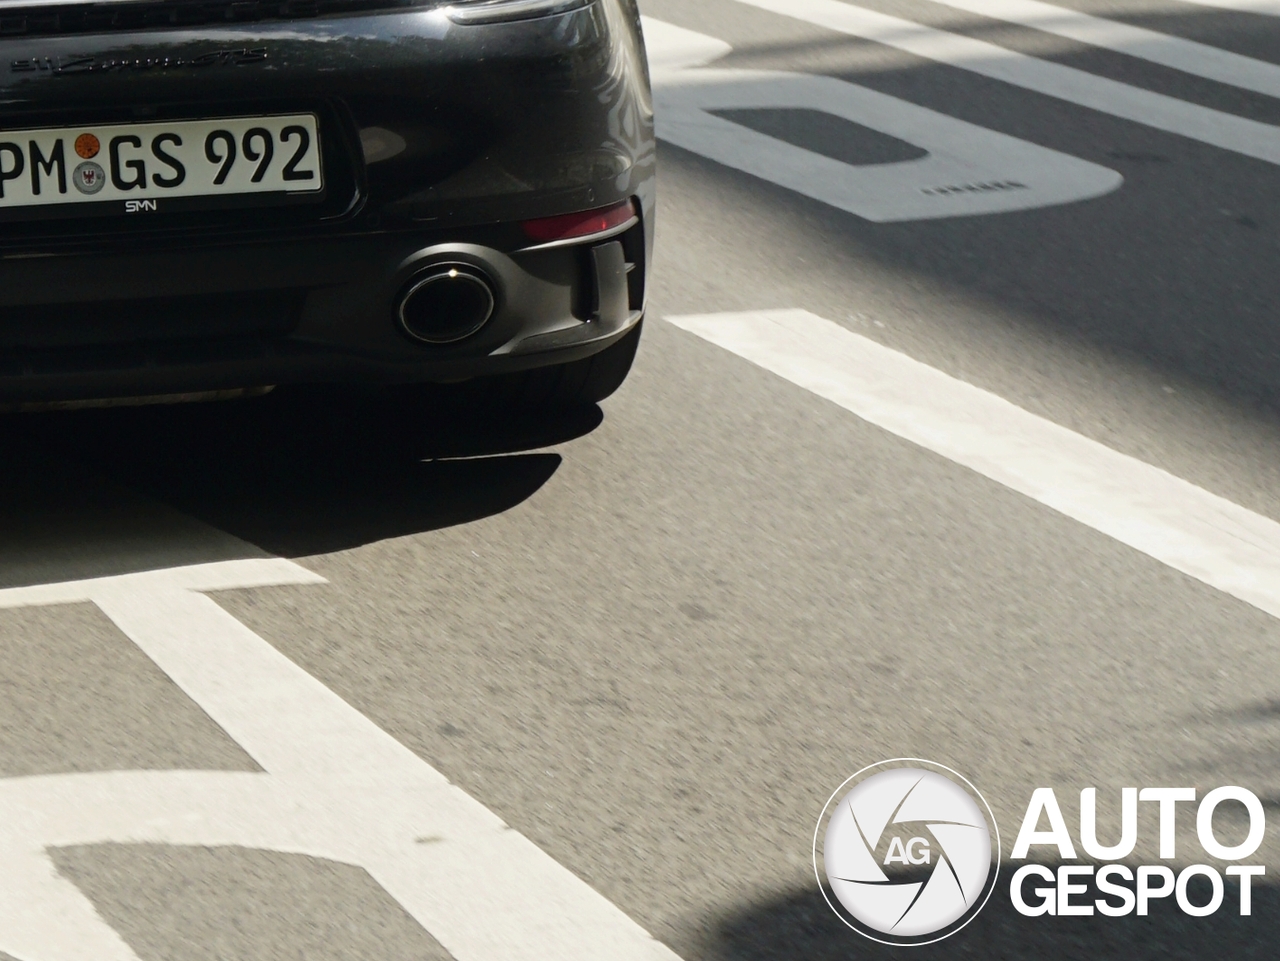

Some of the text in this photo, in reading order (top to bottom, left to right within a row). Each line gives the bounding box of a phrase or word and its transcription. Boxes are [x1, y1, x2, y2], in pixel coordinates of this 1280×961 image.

[108, 132, 187, 191] GS
[204, 124, 315, 186] 992
[125, 199, 158, 213] SMN
